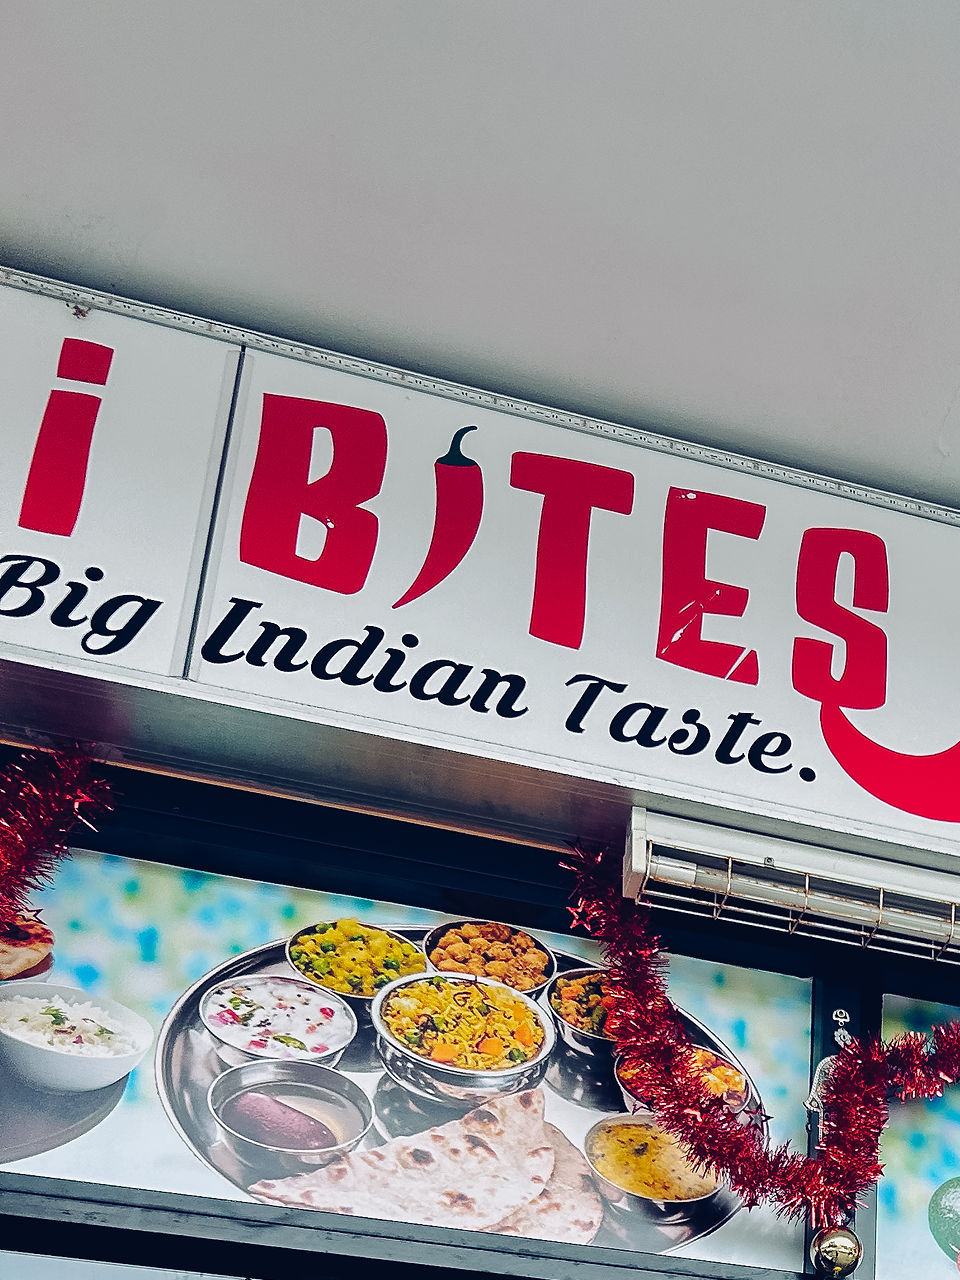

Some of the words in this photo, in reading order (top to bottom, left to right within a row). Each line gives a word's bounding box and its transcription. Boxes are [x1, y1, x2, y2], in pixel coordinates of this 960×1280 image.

[0, 553, 165, 656] Big
[200, 596, 529, 719] Indian
[564, 673, 818, 783] Taste.
